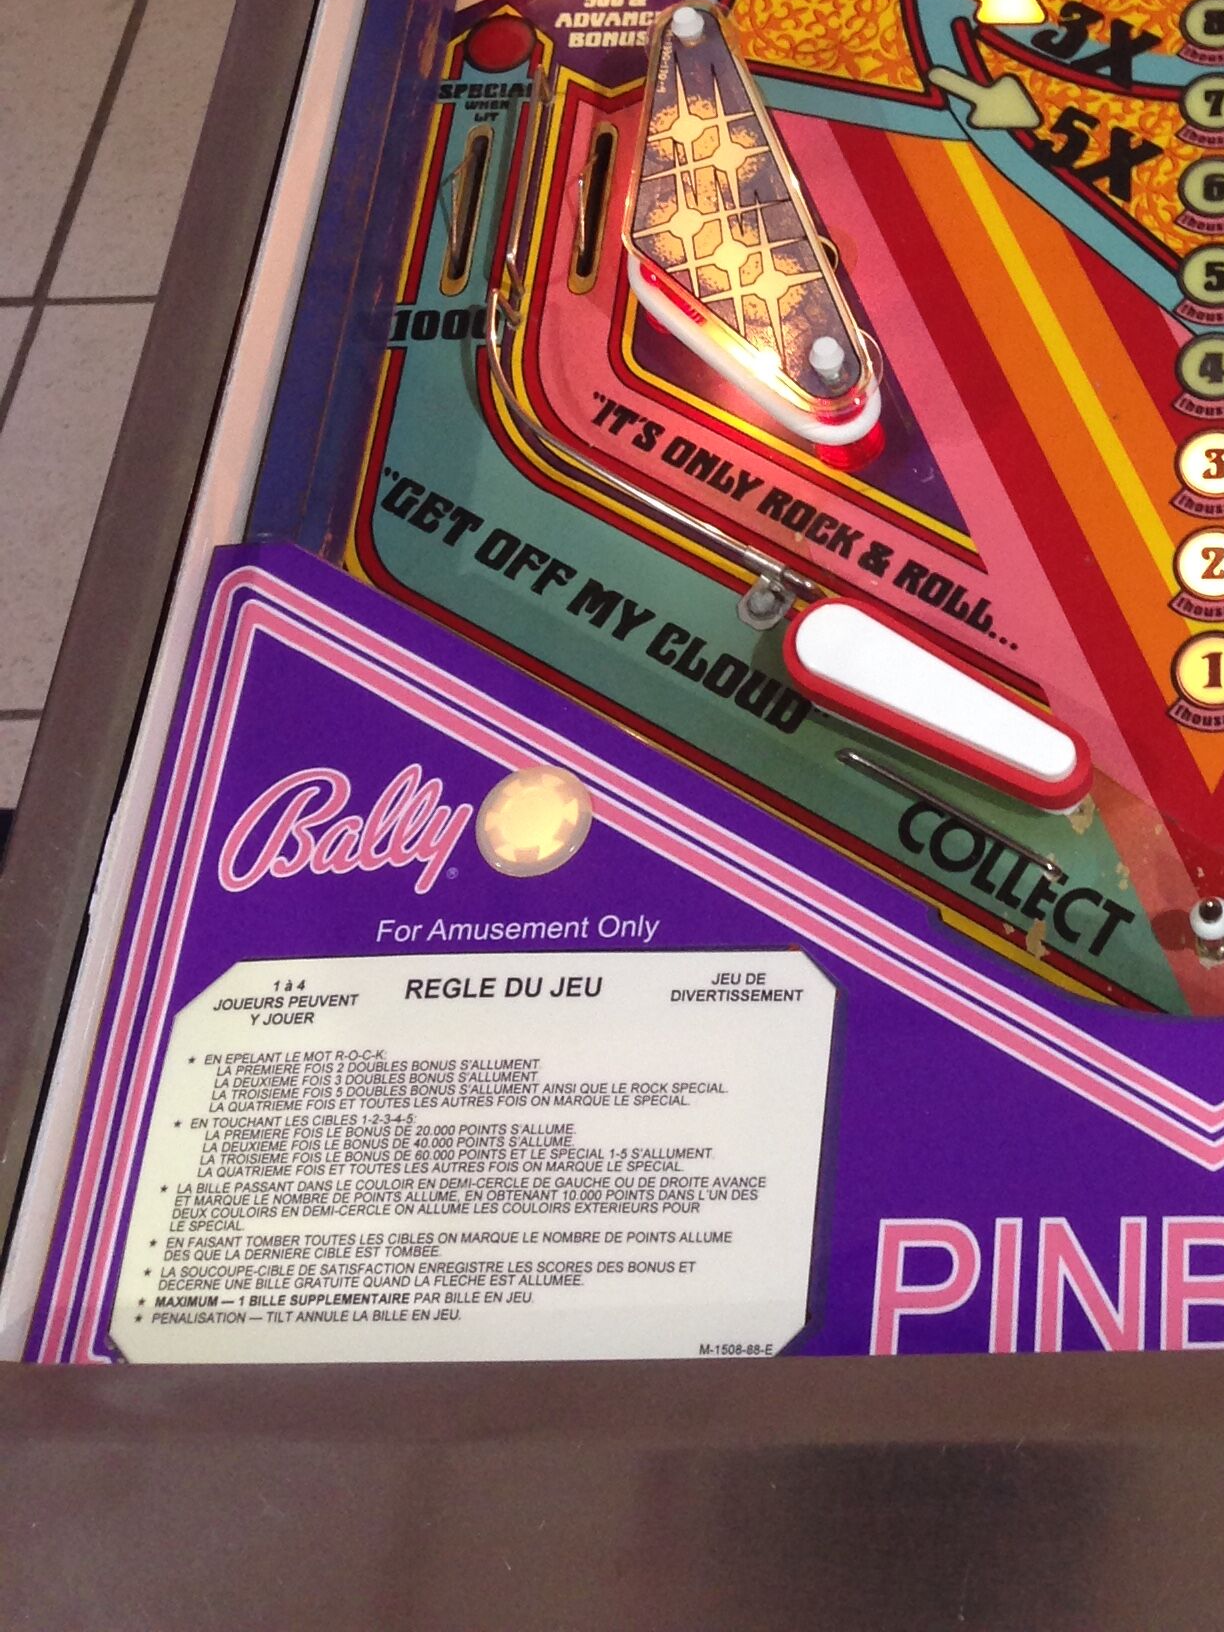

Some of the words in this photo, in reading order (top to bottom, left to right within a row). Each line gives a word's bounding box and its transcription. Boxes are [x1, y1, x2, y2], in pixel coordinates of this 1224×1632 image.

[592, 391, 666, 453] "IT'S
[661, 436, 764, 502] ONLY
[757, 486, 864, 560] ROCK
[858, 540, 896, 579] &
[892, 559, 1020, 652] ROLL...
[381, 466, 485, 547] "GET
[474, 528, 577, 596] OFF
[566, 578, 655, 643] MY
[1200, 546, 1224, 579] 2
[1203, 652, 1223, 688] 1
[217, 763, 473, 894] Bally
[898, 798, 1136, 959] COLLECT
[376, 920, 422, 942] For
[427, 917, 590, 941] Amusement
[597, 914, 661, 944] Only
[404, 978, 497, 1000] REGLE
[504, 978, 543, 998] DU
[549, 977, 602, 997] JEU
[711, 973, 741, 986] JEU
[745, 972, 767, 985] DE
[213, 996, 284, 1011] JOUEURS
[289, 994, 359, 1008] PEUVENT
[669, 989, 804, 1003] DIVERTISSEMENT
[250, 1013, 260, 1025] Y
[263, 1012, 314, 1025] JOUER
[204, 1054, 222, 1065] EN
[225, 1052, 282, 1064] EPELANT
[285, 1052, 300, 1063] LE
[303, 1051, 333, 1062] MOT
[190, 1119, 208, 1129] EN
[212, 1116, 281, 1128] TOUCHANT
[285, 1116, 309, 1126] LES
[312, 1115, 359, 1126] CIBLES
[155, 1296, 218, 1308] MAXIMUM
[249, 1294, 286, 1307] BILLE
[289, 1293, 410, 1306] SUPPLEMENTAIRE
[413, 1292, 441, 1304] PAR
[444, 1292, 481, 1304] BILLE
[484, 1292, 503, 1303] EN
